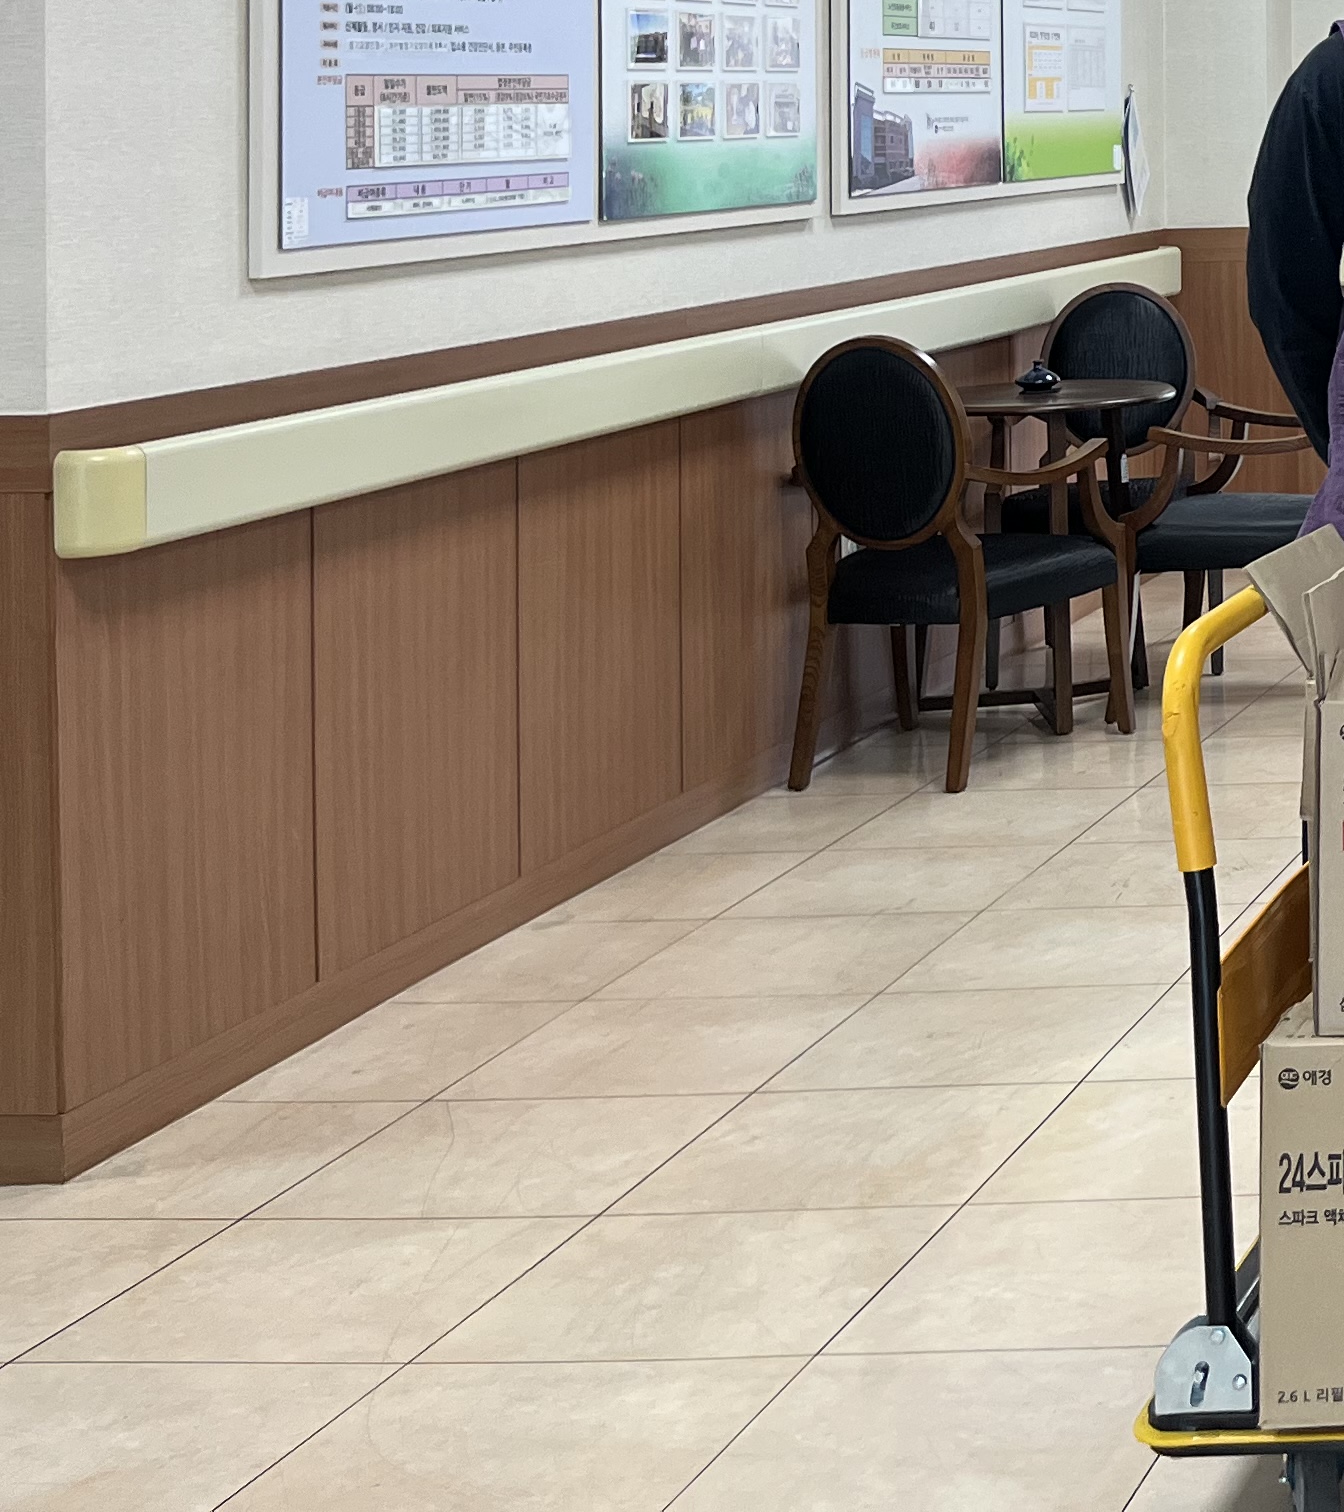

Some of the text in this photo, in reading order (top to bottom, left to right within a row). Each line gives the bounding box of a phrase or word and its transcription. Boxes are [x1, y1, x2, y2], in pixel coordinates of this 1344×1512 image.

[1302, 1069, 1332, 1086] 애경
[1278, 1208, 1319, 1226] 스파크
[1277, 1390, 1298, 1404] 2.6
[1303, 1389, 1311, 1403] L
[1316, 1387, 1344, 1403] 리필
